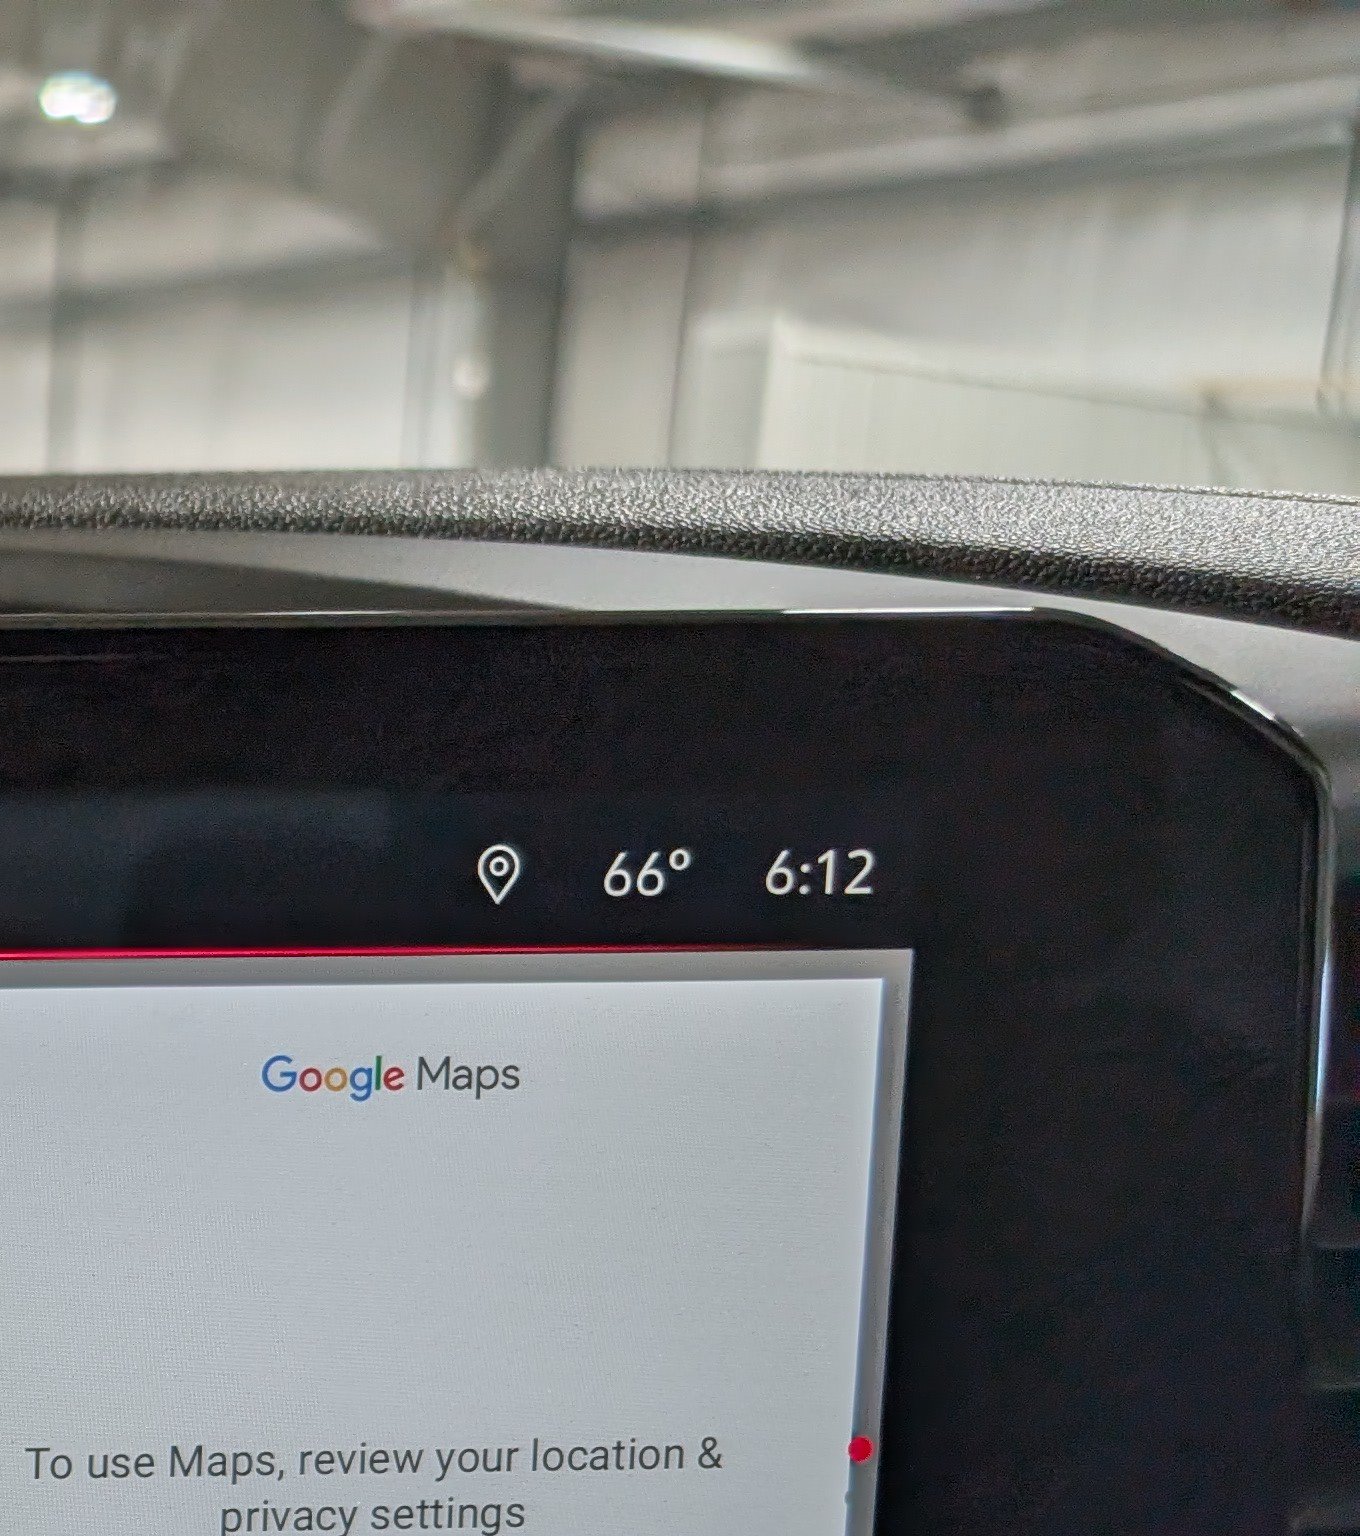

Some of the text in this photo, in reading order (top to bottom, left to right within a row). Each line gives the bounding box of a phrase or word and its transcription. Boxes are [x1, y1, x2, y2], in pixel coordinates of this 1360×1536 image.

[604, 849, 690, 896] 66°
[766, 849, 875, 894] 6:12
[262, 1055, 519, 1101] Google Maps
[25, 1437, 722, 1485] To use Maps, review your location &
[371, 1497, 524, 1536] settings
